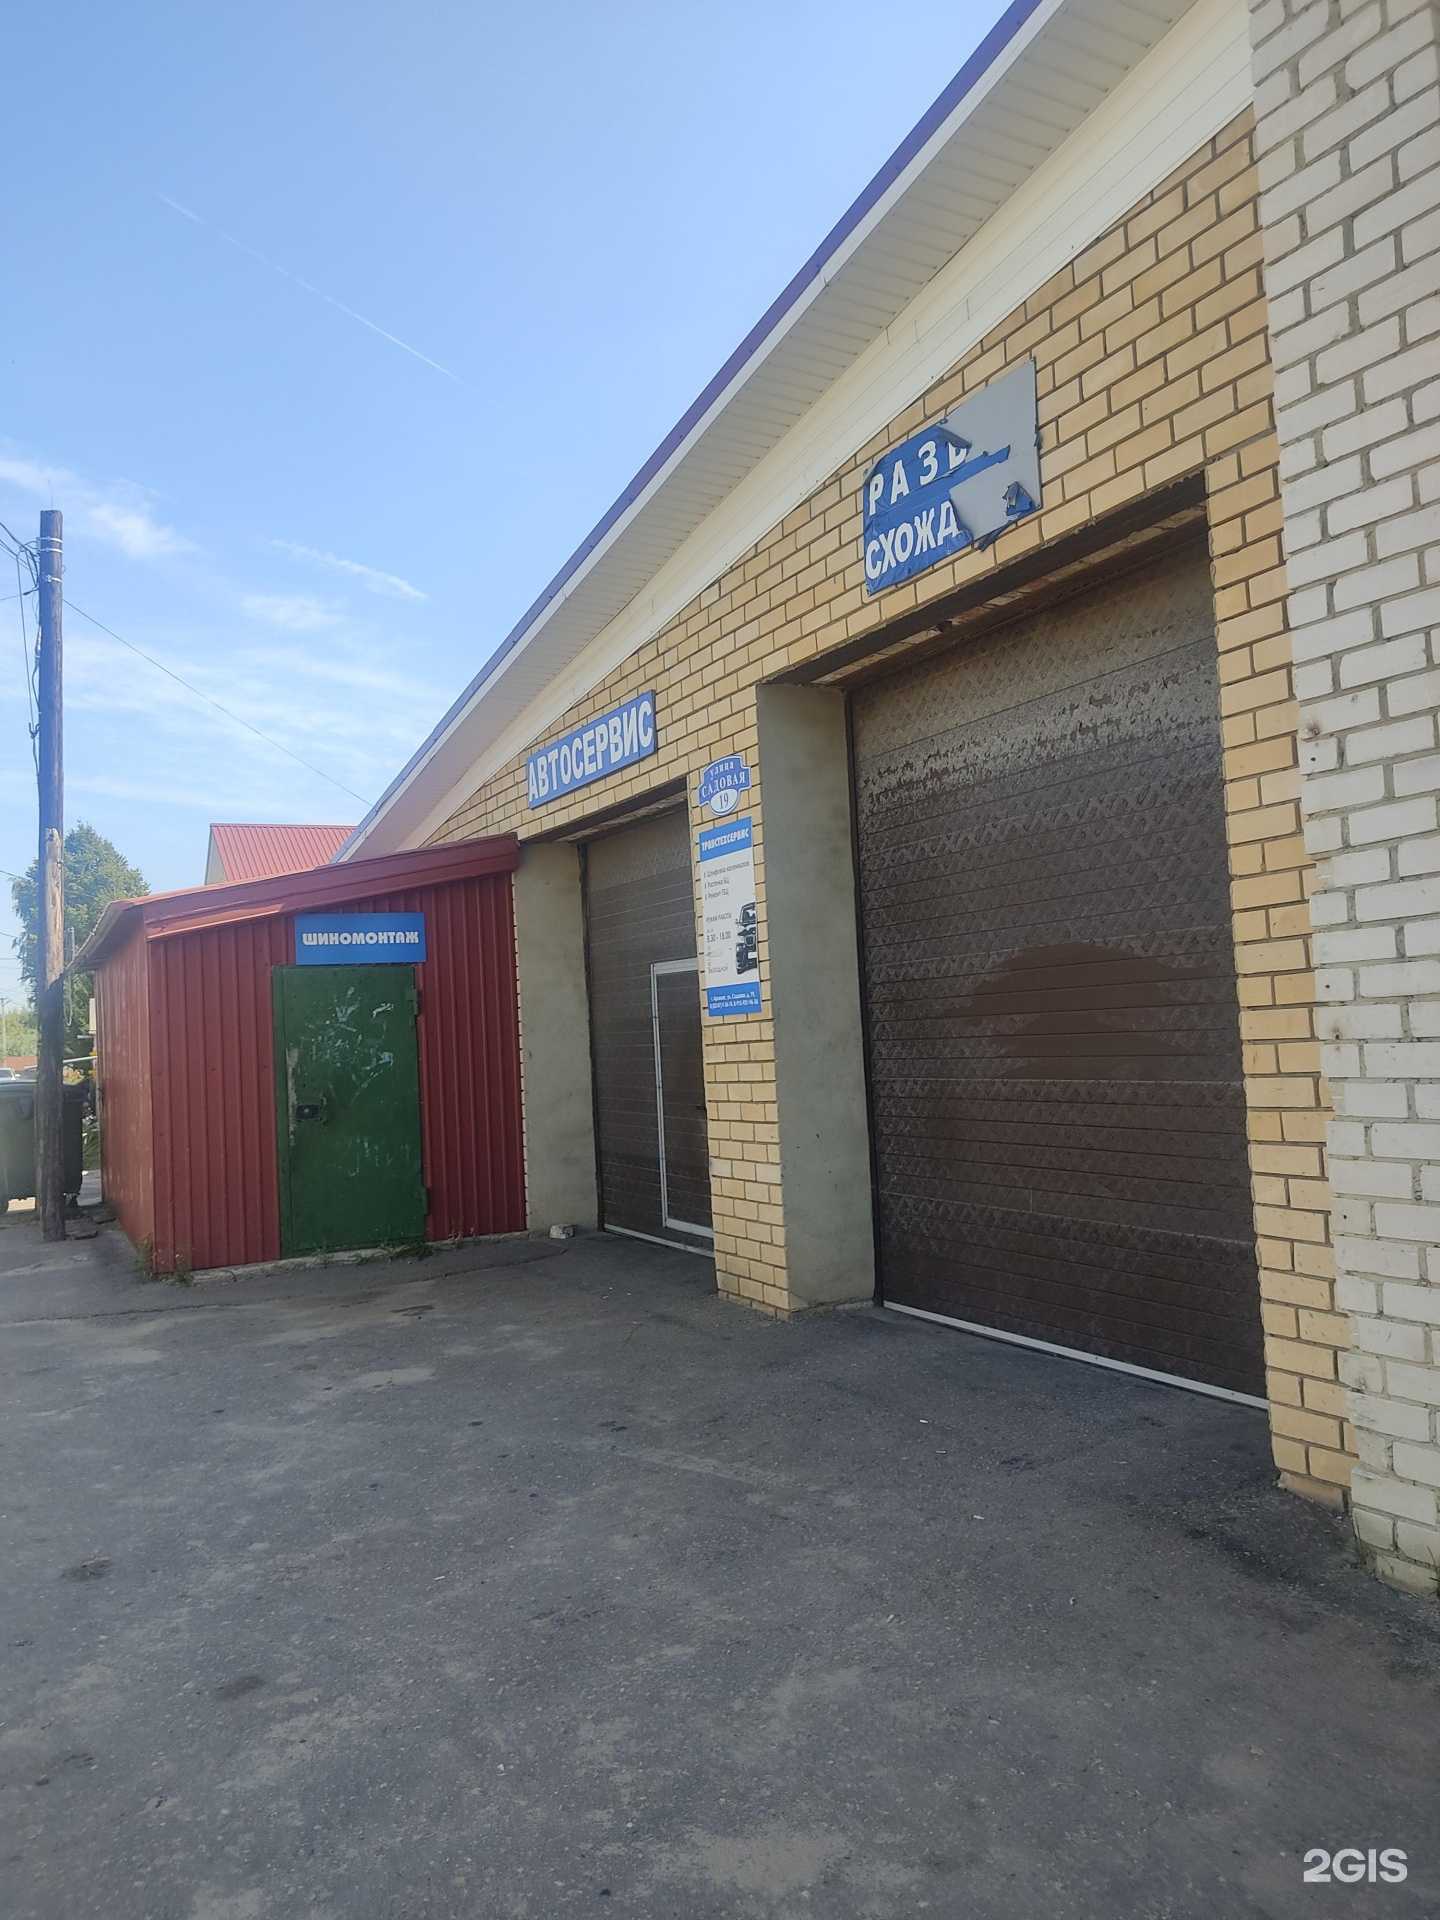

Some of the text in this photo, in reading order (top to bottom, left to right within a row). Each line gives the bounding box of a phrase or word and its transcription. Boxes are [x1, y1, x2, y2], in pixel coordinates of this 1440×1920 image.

[528, 701, 653, 802] АВТОСЕРВИС
[702, 771, 745, 797] САДОВАЯ
[719, 792, 729, 809] 19
[302, 931, 419, 946] ШИНОМОНТАЖ
